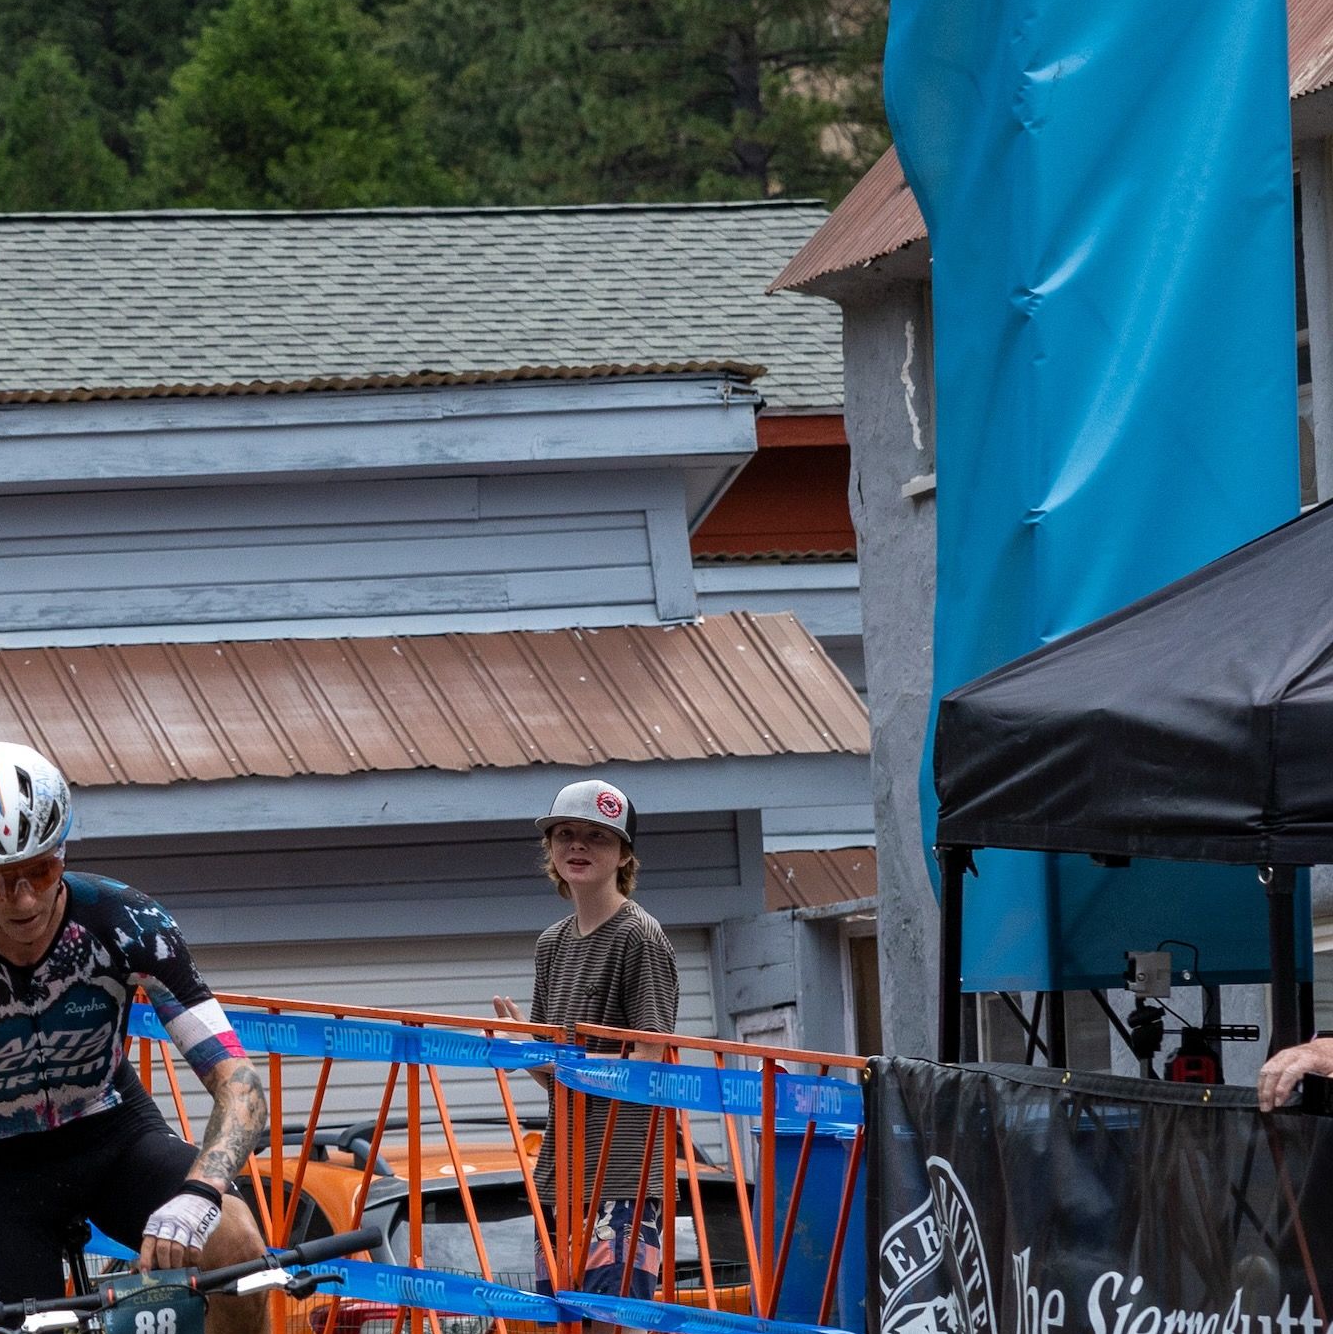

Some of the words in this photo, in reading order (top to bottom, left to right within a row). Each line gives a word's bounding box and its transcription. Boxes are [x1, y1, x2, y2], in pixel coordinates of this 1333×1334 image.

[64, 997, 108, 1017] Rapha
[324, 1026, 393, 1055] SHIMANO
[648, 1071, 701, 1102] SHIMANO
[722, 1078, 780, 1109] SHIMA
[794, 1083, 842, 1115] SHIMANO
[197, 1206, 219, 1235] GIRO
[376, 1272, 446, 1305] SHIMANO
